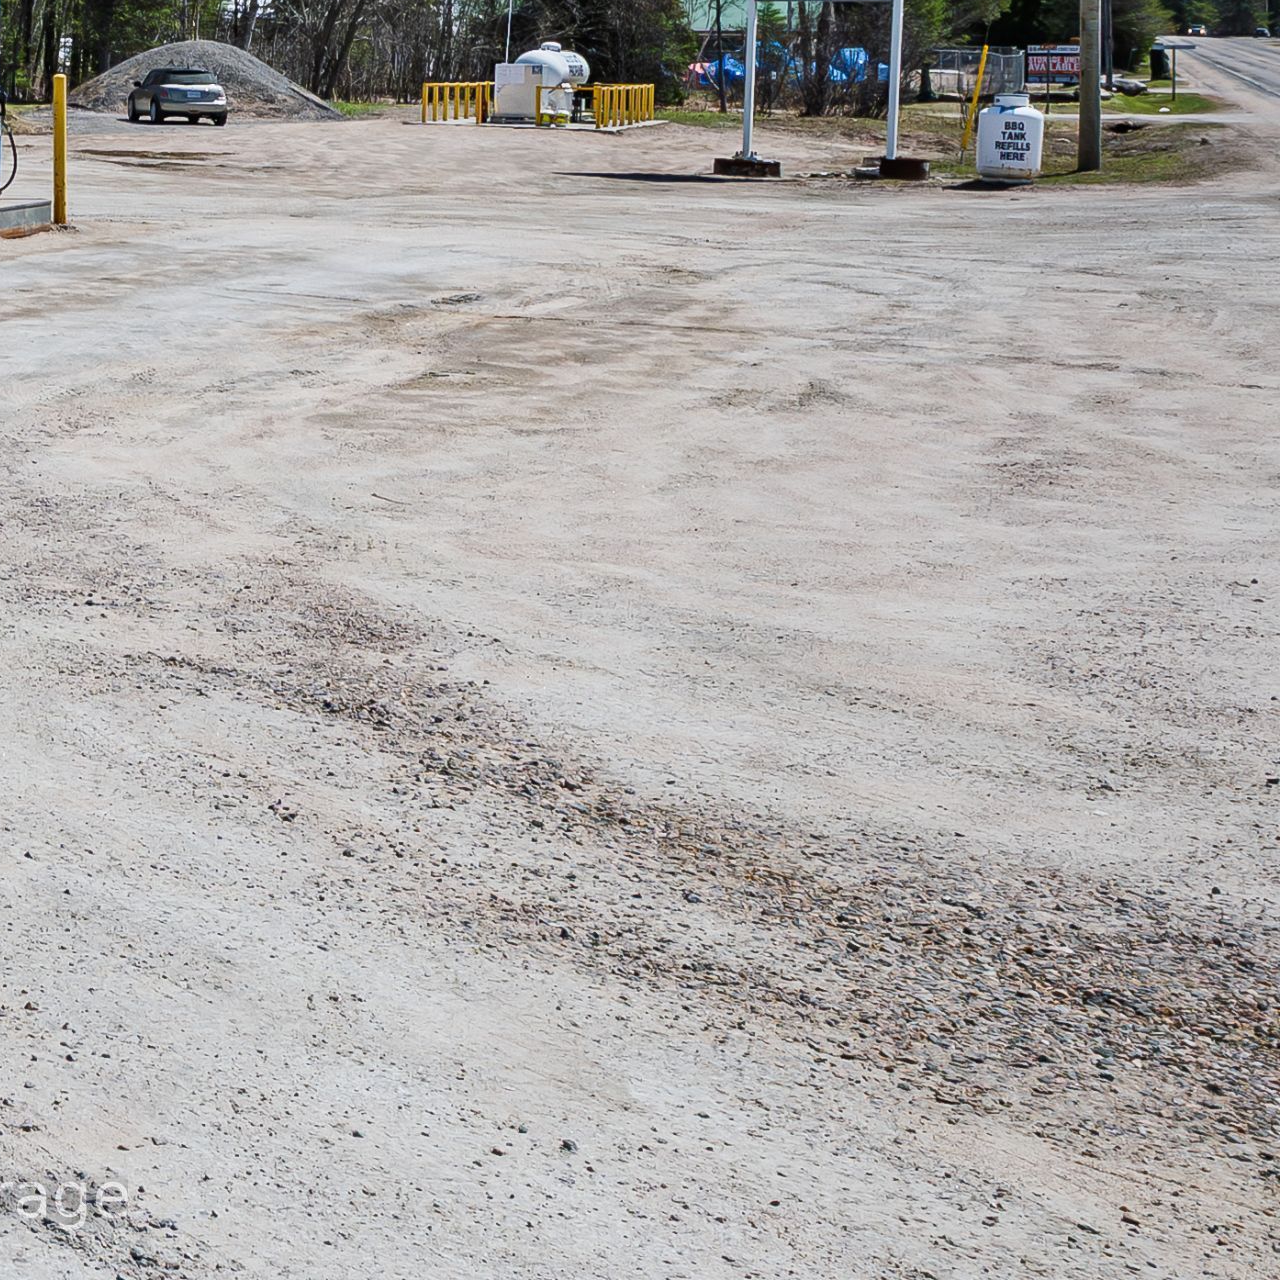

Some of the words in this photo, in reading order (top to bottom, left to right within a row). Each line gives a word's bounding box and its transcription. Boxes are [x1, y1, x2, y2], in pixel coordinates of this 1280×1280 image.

[1004, 121, 1025, 131] BBQ
[1001, 131, 1027, 141] TANK
[995, 141, 1031, 151] REFILLS
[1000, 151, 1025, 161] HERE
